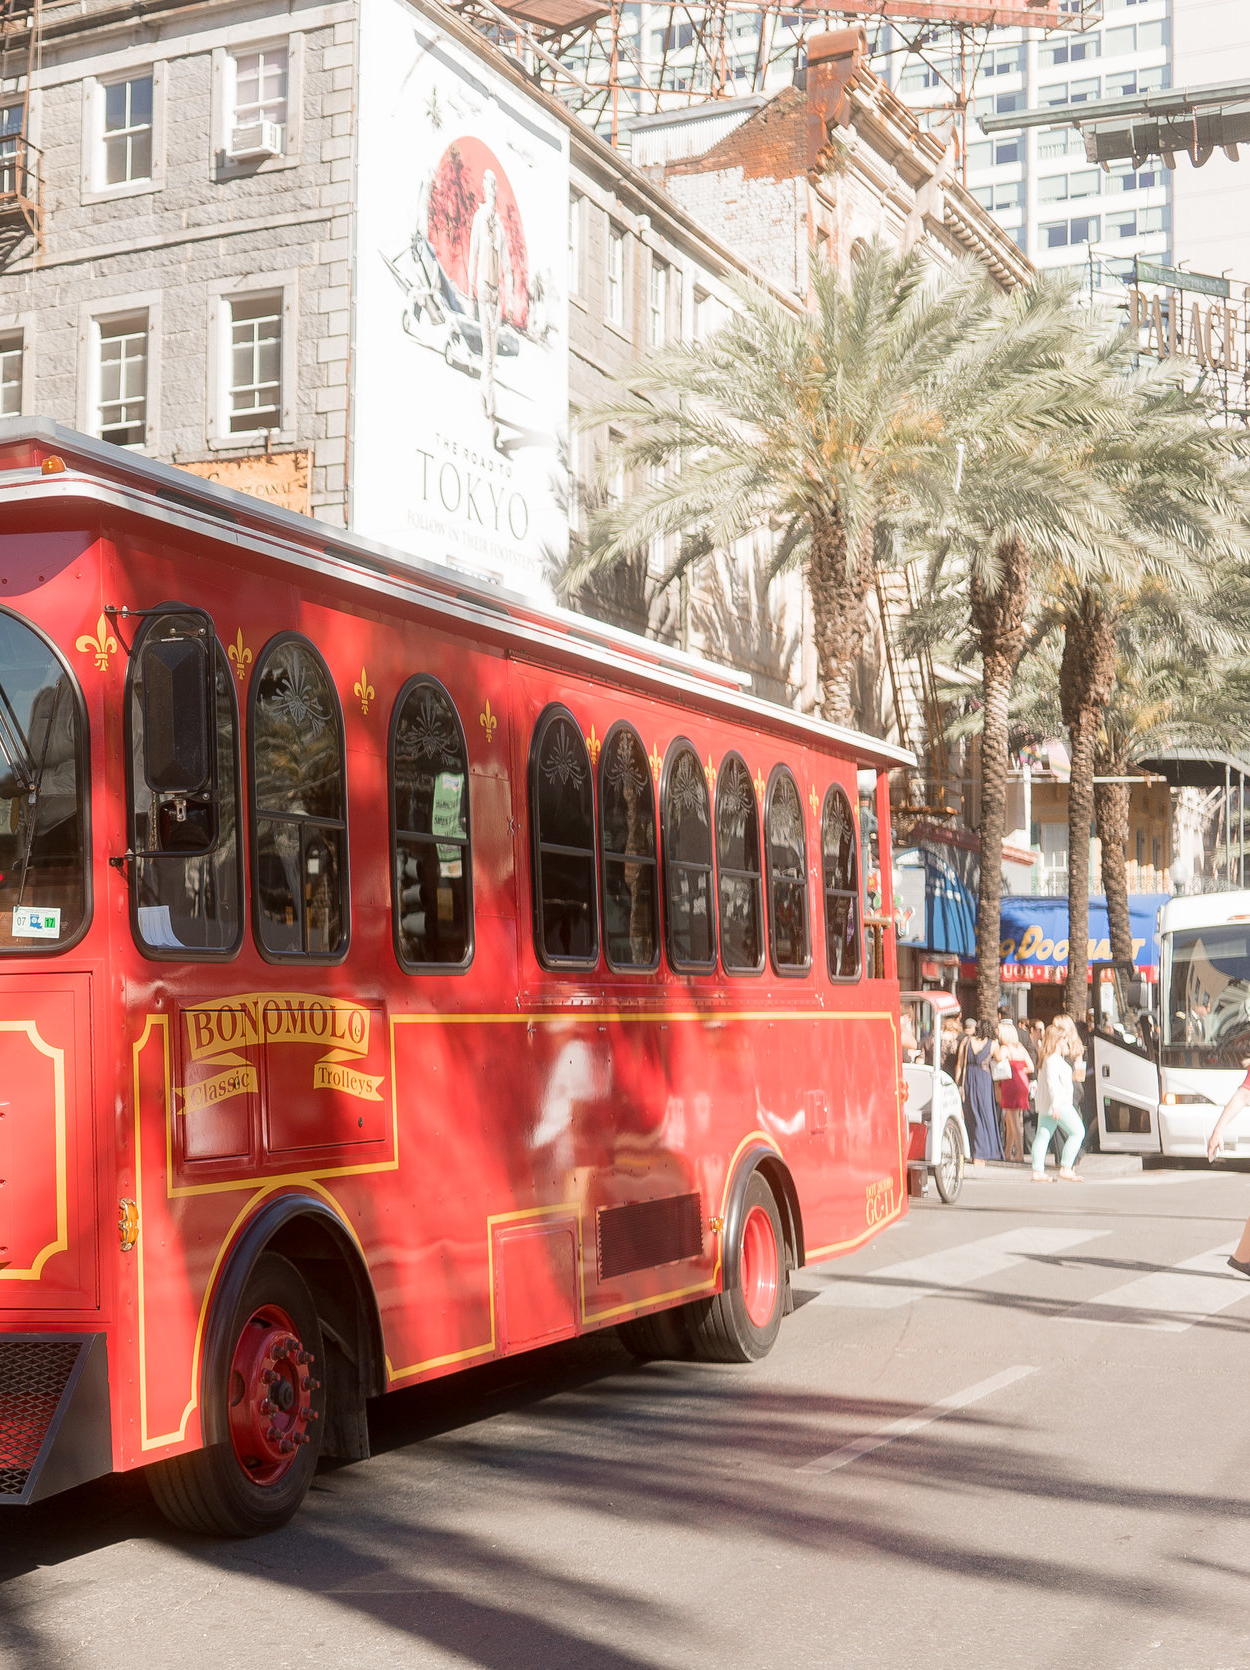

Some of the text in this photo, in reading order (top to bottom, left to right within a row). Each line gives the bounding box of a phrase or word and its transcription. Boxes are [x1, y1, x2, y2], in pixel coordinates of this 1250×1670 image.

[1129, 289, 1238, 371] PALACE
[463, 448, 494, 472] ROAD
[499, 463, 512, 478] TO
[416, 448, 529, 540] TOKYO
[16, 916, 55, 928] 07 17
[192, 999, 366, 1050] BONOMOLO
[190, 1070, 251, 1107] Classic
[318, 1066, 374, 1096] Trolleys
